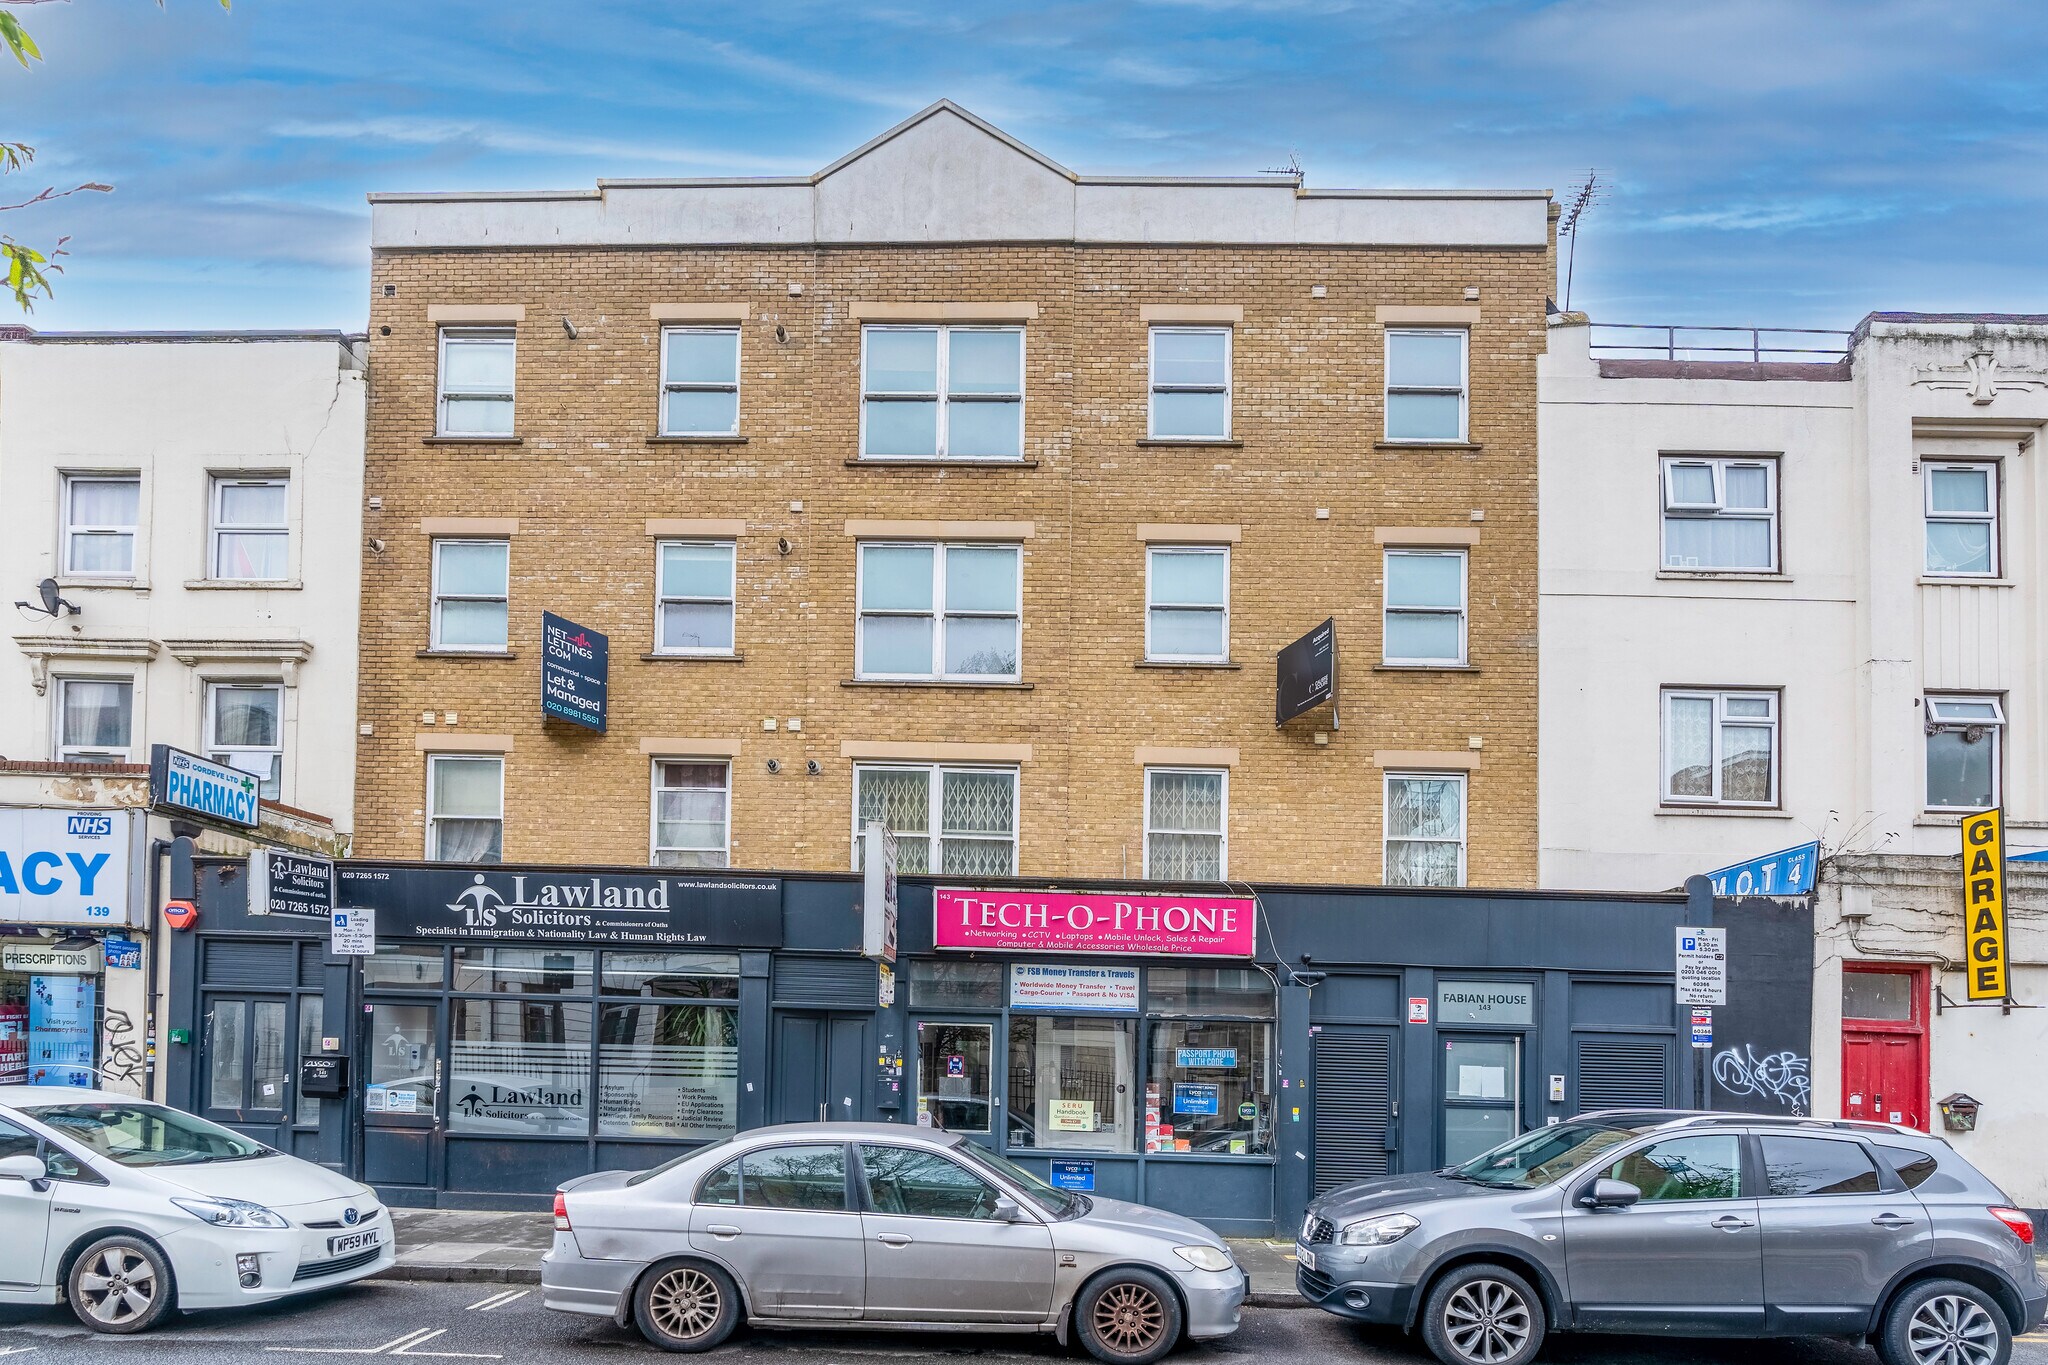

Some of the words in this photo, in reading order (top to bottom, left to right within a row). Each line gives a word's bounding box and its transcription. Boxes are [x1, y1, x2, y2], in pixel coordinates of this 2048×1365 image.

[547, 625, 568, 640] NET
[548, 635, 592, 659] LETTINGS
[548, 646, 571, 661] COM
[547, 661, 580, 677] commercial
[584, 675, 600, 685] space
[548, 672, 566, 686] Let
[568, 680, 576, 691] &
[548, 684, 600, 712] Managed
[546, 701, 562, 712] 020
[563, 706, 580, 718] 8981
[582, 713, 599, 724] 5551
[173, 756, 190, 769] NHS
[192, 764, 224, 780] CORDEVE
[226, 774, 238, 784] LTD
[169, 770, 256, 823] PHARMACY
[69, 818, 109, 834] NHS
[1788, 854, 1805, 863] CLASS
[288, 860, 329, 878] Lawland
[1788, 863, 1801, 885] 4
[292, 875, 324, 888] Solicitors
[678, 881, 777, 890] www.lawlandsolicitors.co.uk
[279, 887, 310, 897] Commissioners
[512, 876, 670, 909] Lawland
[86, 906, 110, 917] 139
[271, 899, 285, 910] 020
[288, 901, 308, 913] 7265
[310, 904, 329, 915] 1572
[1968, 820, 1999, 991] GARAGE
[466, 908, 497, 927] LS
[512, 909, 591, 926] Solicitors
[954, 898, 1237, 932] TECH-O-PHONE
[416, 926, 457, 936] Specialist
[459, 927, 468, 936] in
[470, 928, 525, 938] Immigration
[537, 929, 586, 940] Nationality
[588, 931, 607, 939] Law
[621, 932, 653, 941] Human
[657, 933, 684, 943] Rights
[687, 933, 706, 942] Law
[970, 930, 1017, 939] Networking
[1061, 932, 1093, 940] Laptops
[1134, 934, 1163, 943] Unlock,
[1199, 936, 1225, 944] Repair
[997, 940, 1035, 949] Computer
[1685, 939, 1694, 949] P
[5, 953, 87, 965] PRESCRIPTIONS
[1042, 968, 1066, 977] Money
[1068, 969, 1099, 978] Transfer
[1108, 970, 1135, 979] Travels
[1444, 993, 1484, 1003] FABIAN
[1488, 995, 1526, 1005] HOUSE
[1178, 1050, 1212, 1058] PASSPORT
[1213, 1050, 1235, 1058] PHOTO
[491, 1086, 582, 1106] Lawland
[464, 1107, 482, 1117] LS
[486, 1110, 528, 1119] Solicitors
[338, 1236, 360, 1252] WP59
